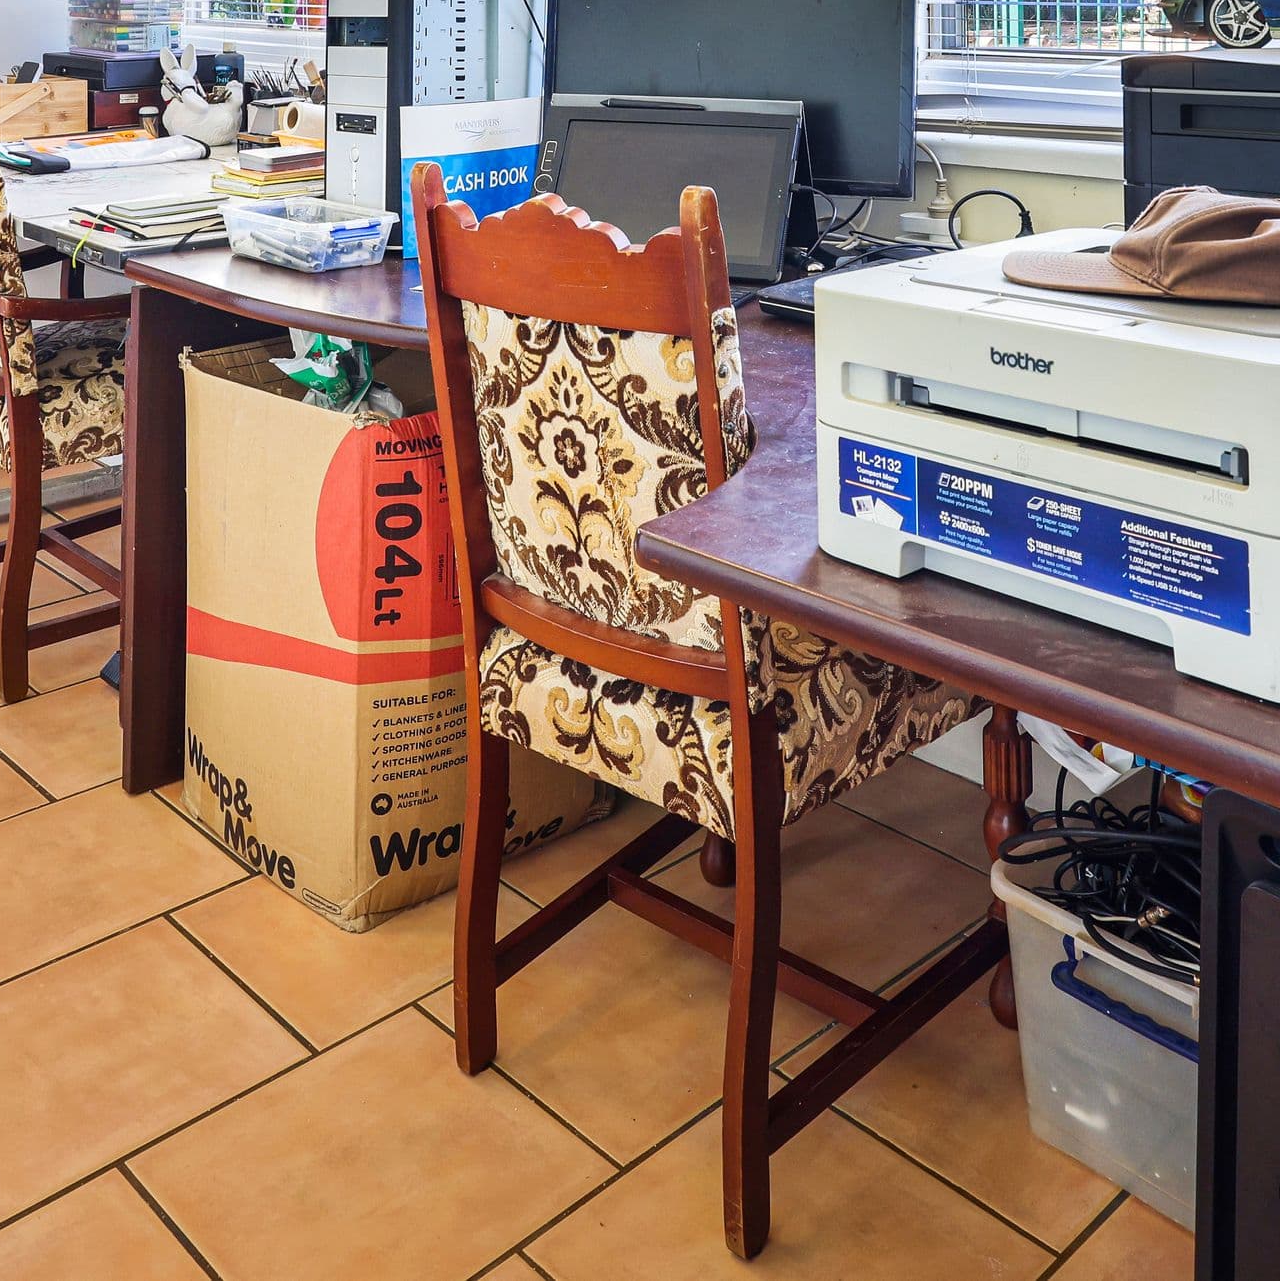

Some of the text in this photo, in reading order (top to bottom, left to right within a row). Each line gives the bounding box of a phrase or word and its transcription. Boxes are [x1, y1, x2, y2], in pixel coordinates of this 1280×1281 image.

[443, 166, 528, 194] CASH BOOK
[990, 346, 1054, 375] brother
[375, 434, 442, 456] MOVING
[853, 448, 902, 475] HL-2132
[950, 475, 993, 500] 20PPM
[1120, 520, 1214, 553] Additional Features
[372, 689, 456, 709] SUITABLE FOR:
[383, 713, 434, 727] BLANKETS
[383, 716, 467, 740] CLOTHING & FOOT
[382, 729, 467, 754] SPORTING GOODS
[382, 747, 452, 768] KITCHENWARE
[382, 767, 428, 782] GENERAL
[396, 794, 439, 809] AUSTRALIA
[397, 790, 420, 800] MADE
[504, 816, 563, 855] ove
[223, 809, 296, 889] Move
[370, 823, 464, 877] Wra
